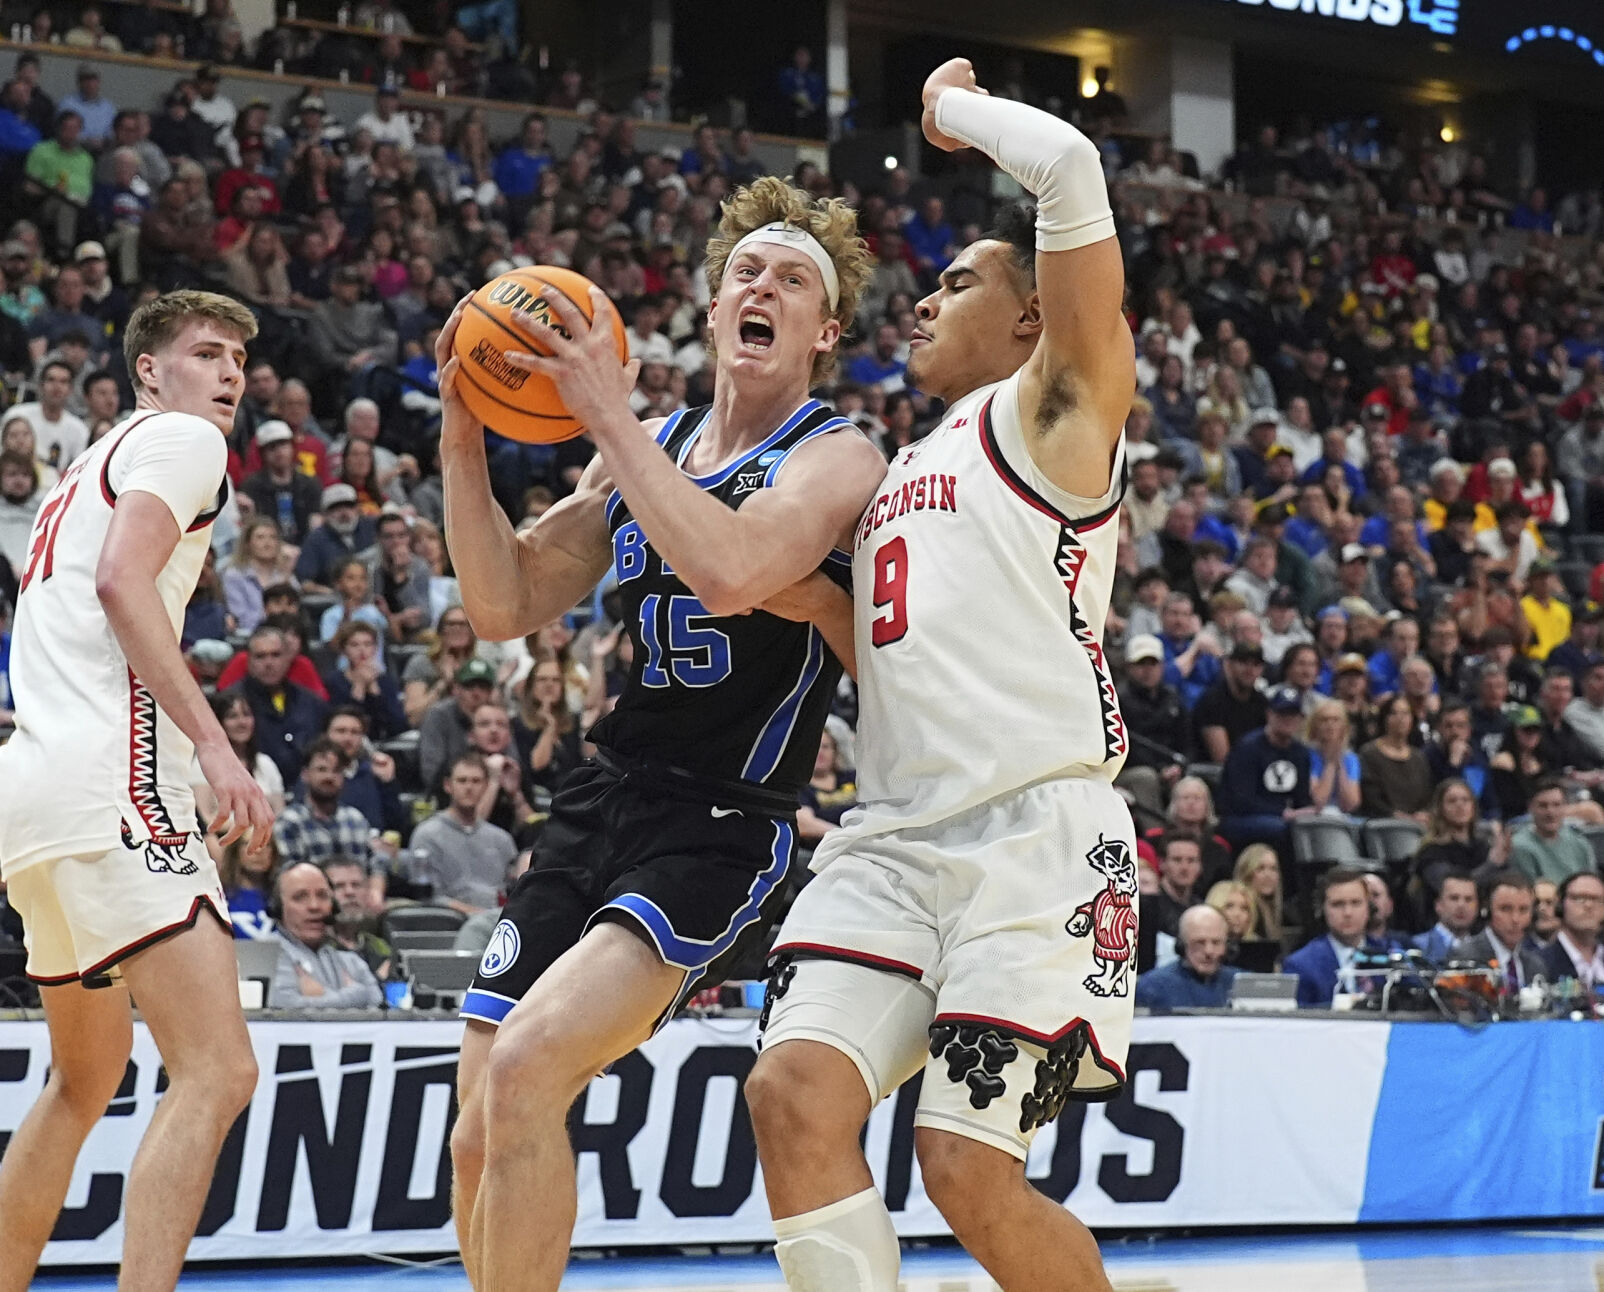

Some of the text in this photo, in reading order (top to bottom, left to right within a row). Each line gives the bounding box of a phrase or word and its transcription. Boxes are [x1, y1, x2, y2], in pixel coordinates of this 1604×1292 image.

[20, 480, 79, 596] 31
[852, 473, 957, 562] ISCONSIN
[639, 593, 732, 688] 15
[872, 535, 909, 649] 9
